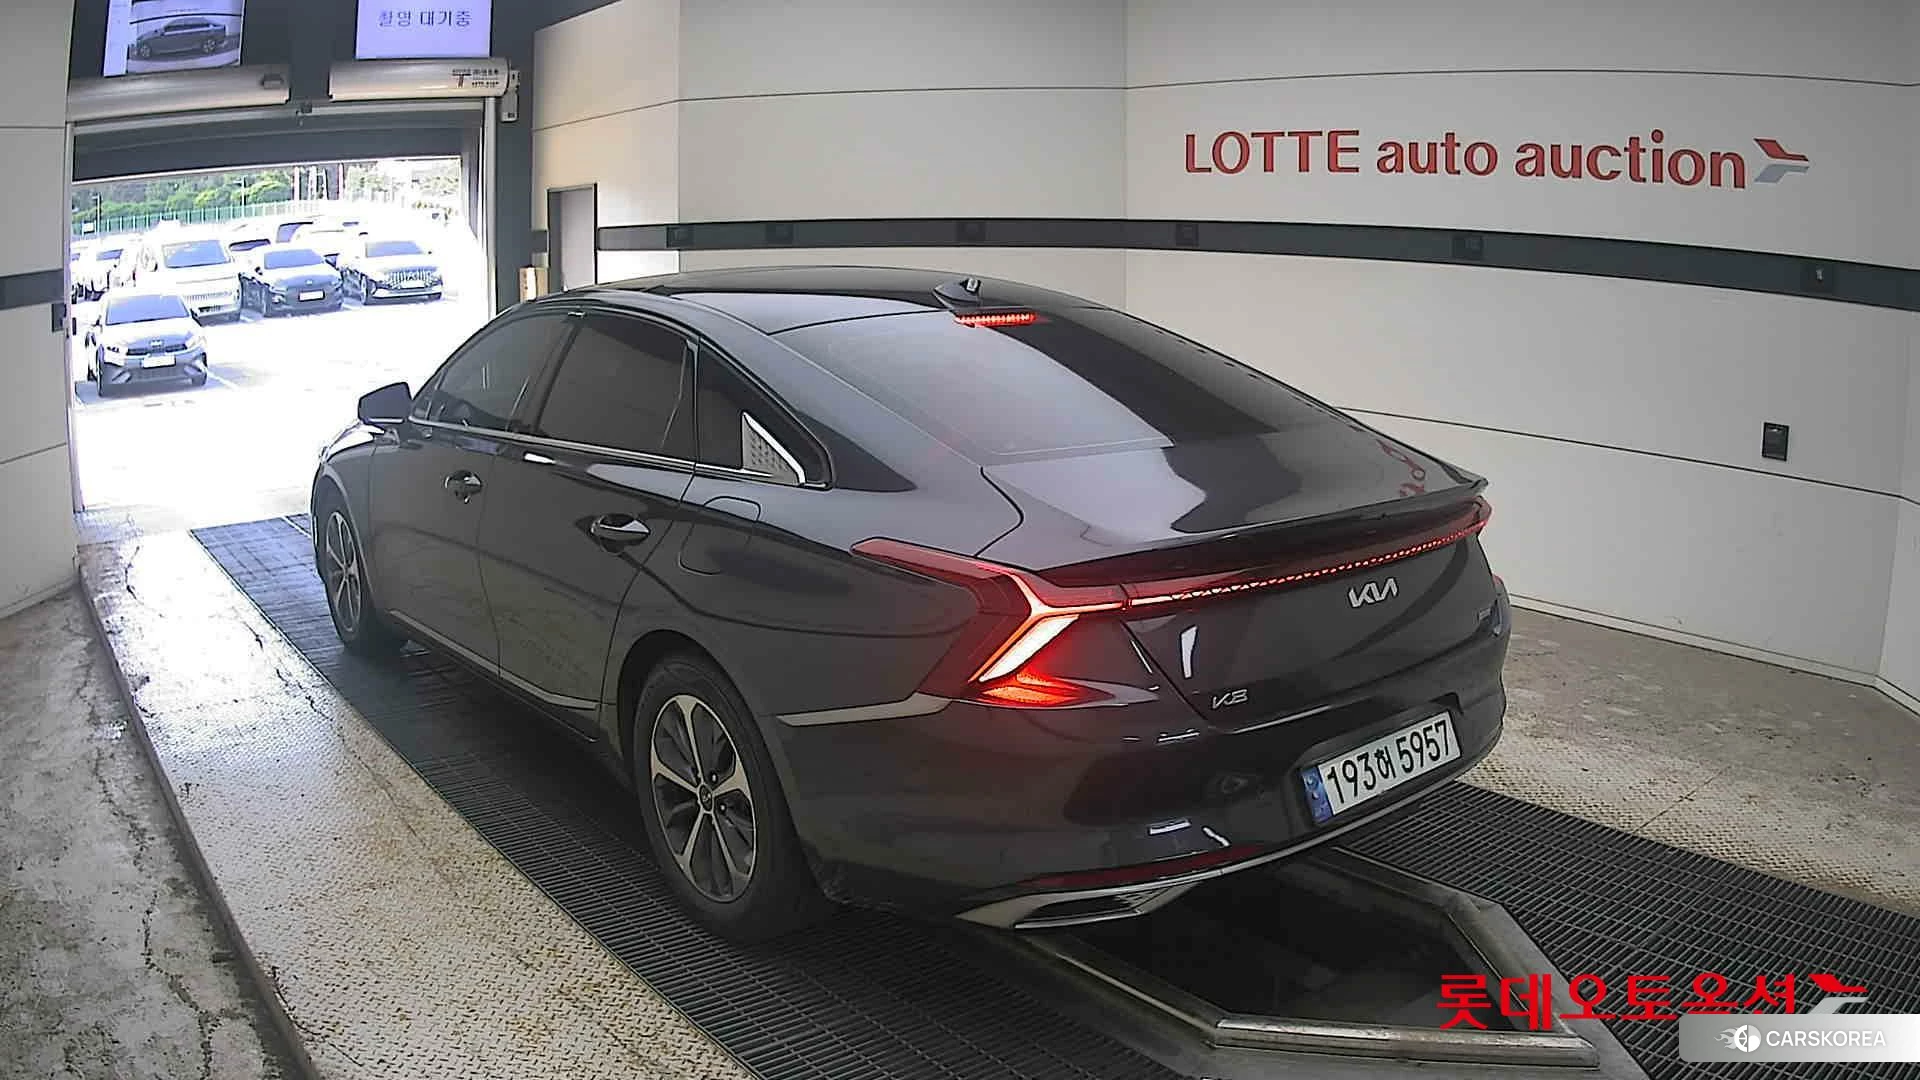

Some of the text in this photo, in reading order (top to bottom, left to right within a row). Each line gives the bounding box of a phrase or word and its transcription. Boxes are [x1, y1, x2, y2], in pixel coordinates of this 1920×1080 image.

[420, 10, 471, 27] 대기중
[1185, 129, 1746, 189] LOTTE auto auction
[1348, 578, 1398, 607] KIA
[1212, 688, 1248, 709] K8
